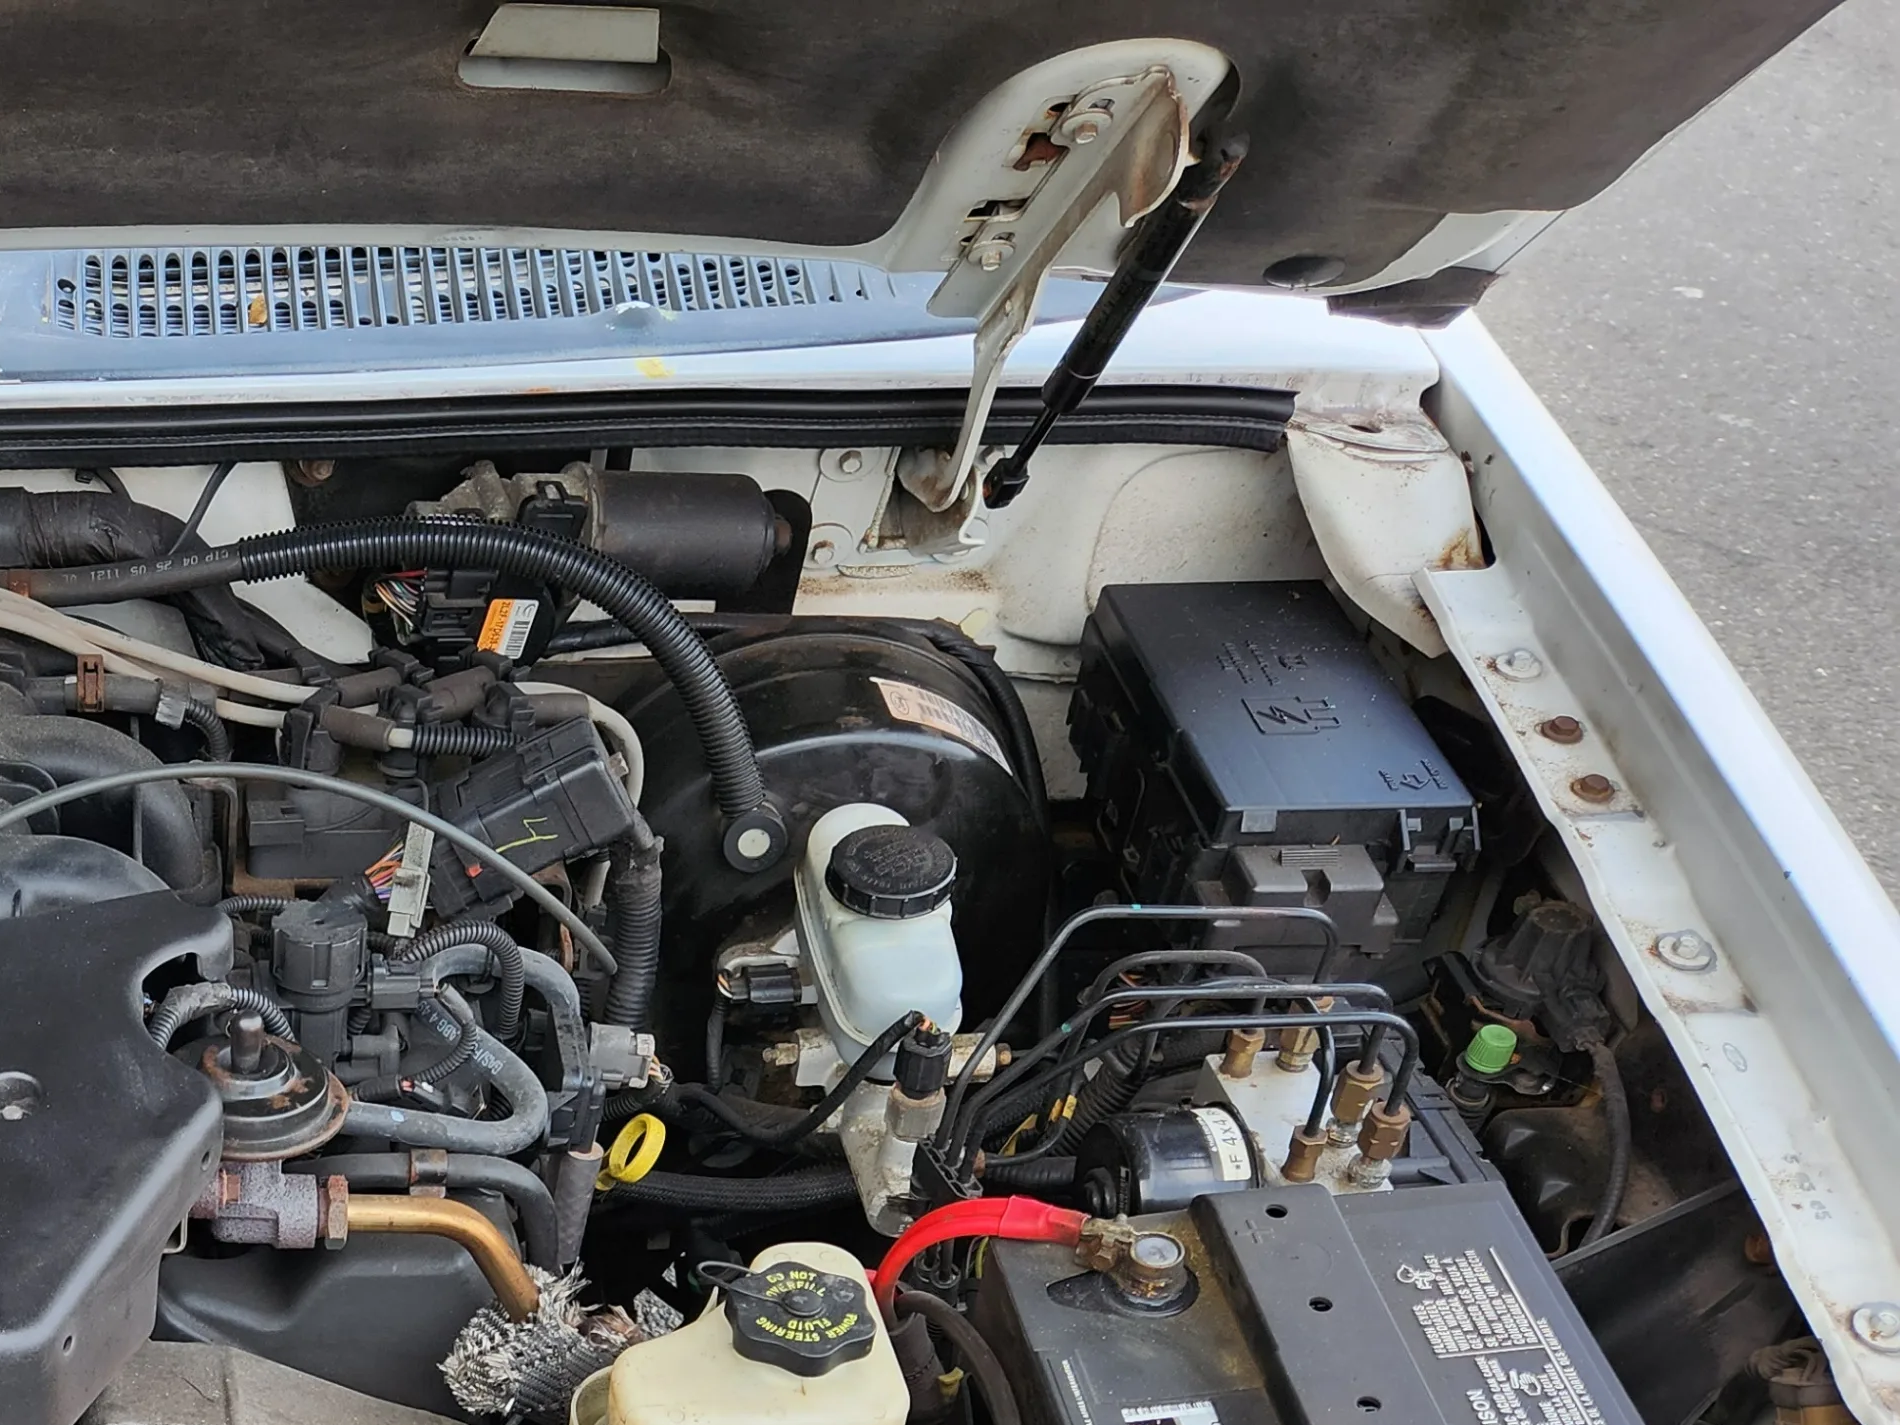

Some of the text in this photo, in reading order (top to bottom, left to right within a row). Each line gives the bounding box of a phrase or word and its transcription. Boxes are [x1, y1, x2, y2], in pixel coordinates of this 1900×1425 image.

[766, 1271, 817, 1283] DO NOT
[766, 1281, 827, 1297] OVERFILL
[755, 1313, 858, 1342] POWER STEERING
[788, 1317, 832, 1331] FLUID
[1411, 1304, 1446, 1353] FLUSH EYES
[1434, 1298, 1470, 1350] WITH WATER
[1491, 1393, 1513, 1413] ACID
